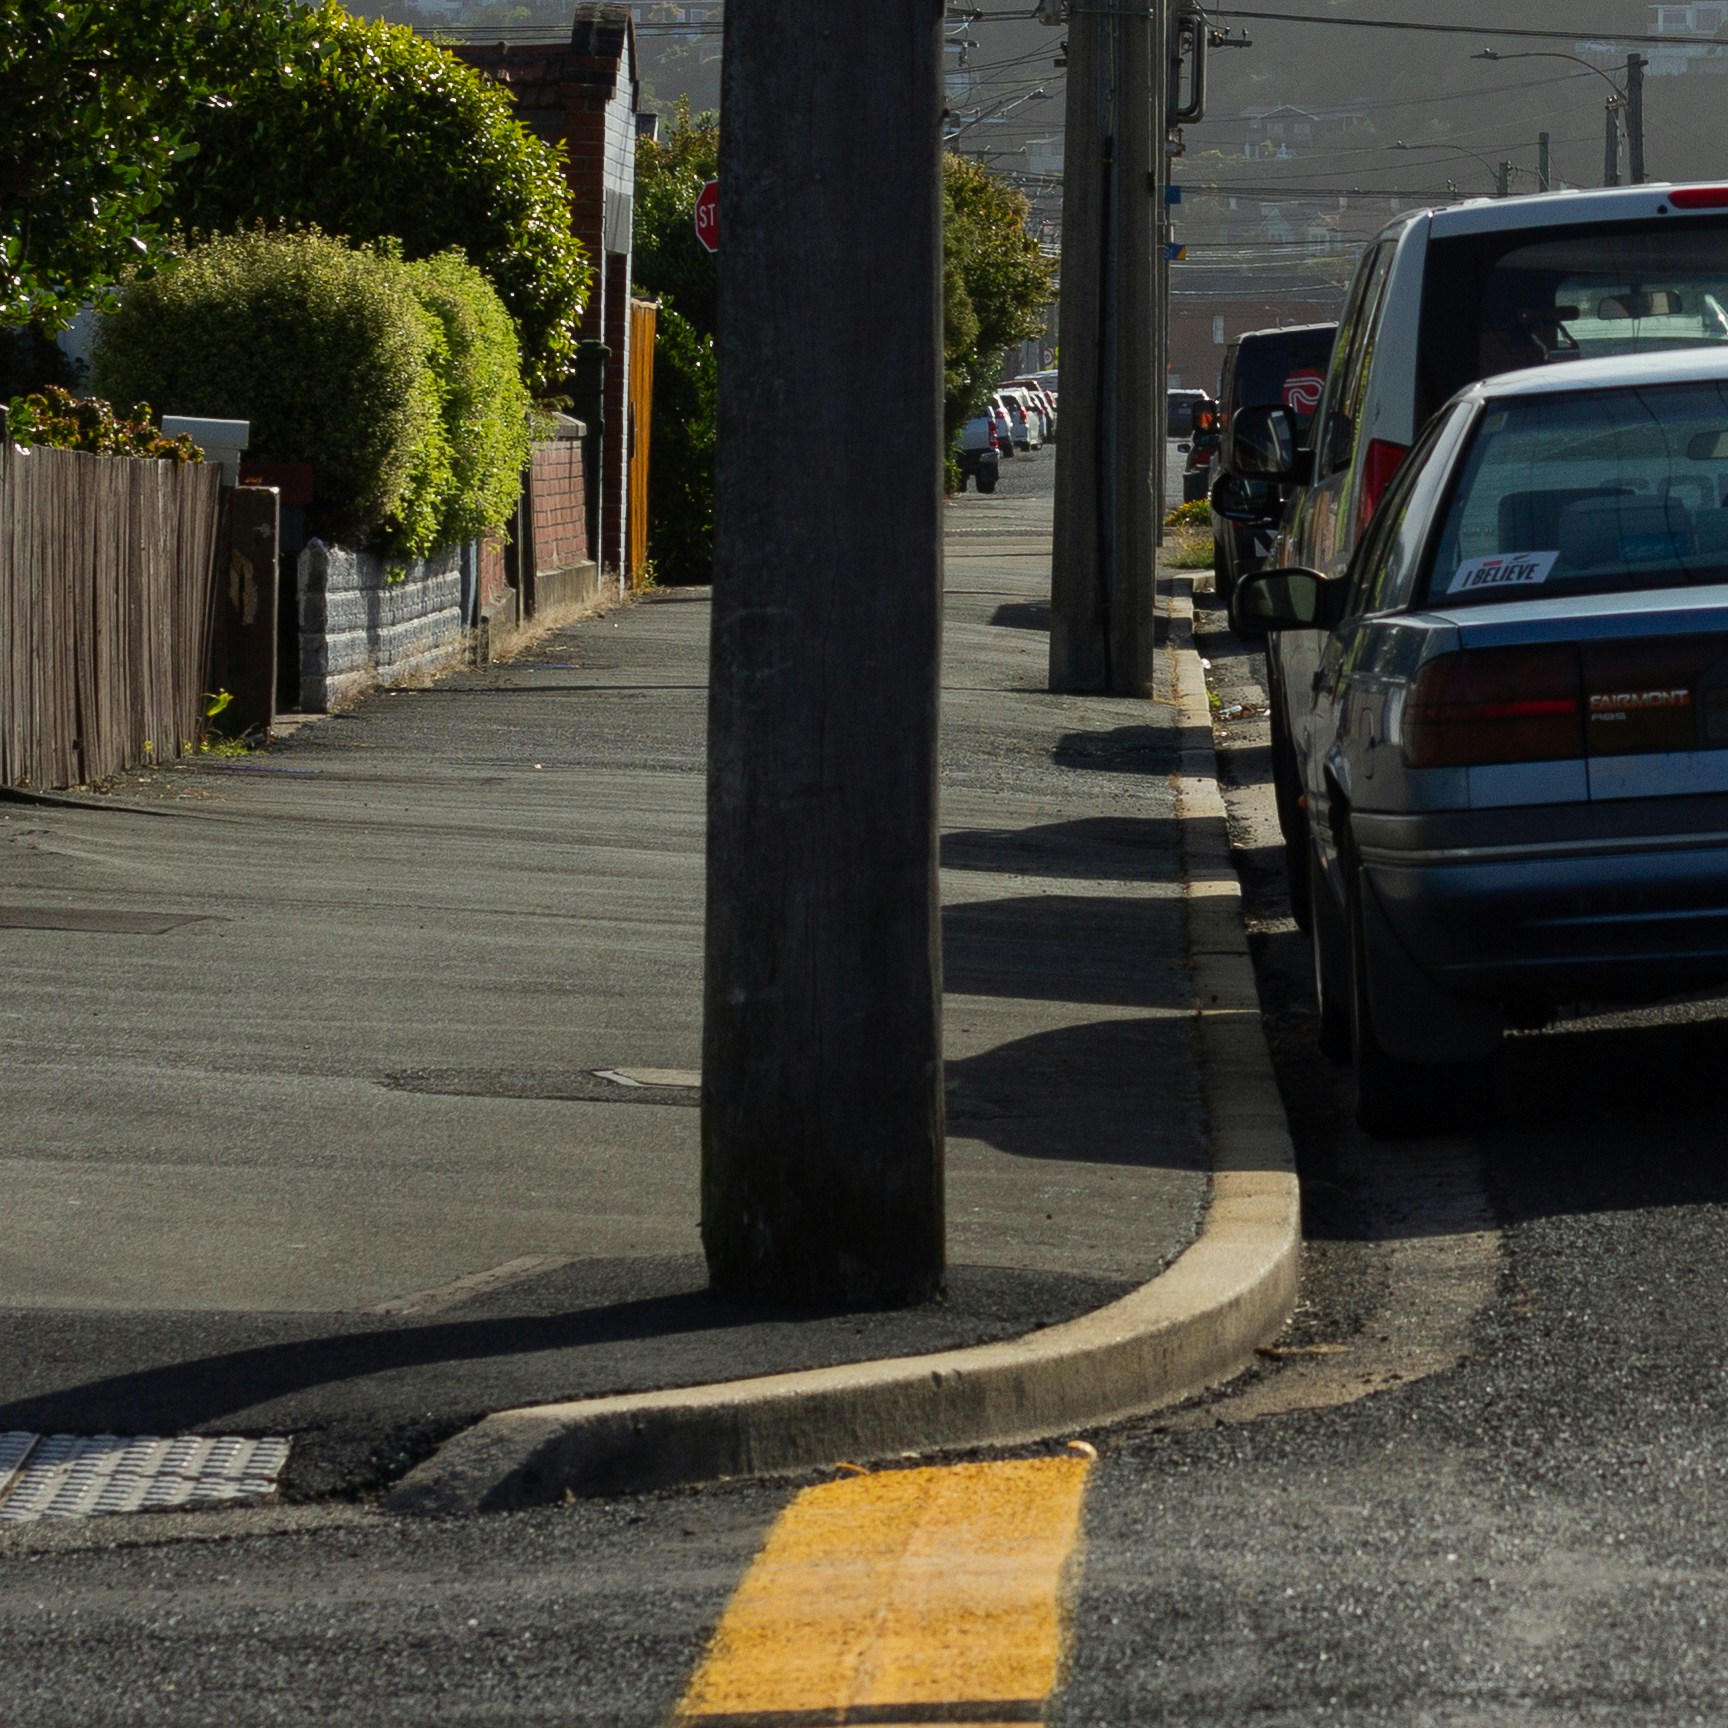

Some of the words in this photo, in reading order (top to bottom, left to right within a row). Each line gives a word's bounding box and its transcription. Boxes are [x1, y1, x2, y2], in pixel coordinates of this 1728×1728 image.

[700, 203, 716, 228] ST
[1462, 571, 1473, 587] I
[1471, 563, 1541, 586] BELIEVE
[1590, 690, 1688, 710] FAIRMONT
